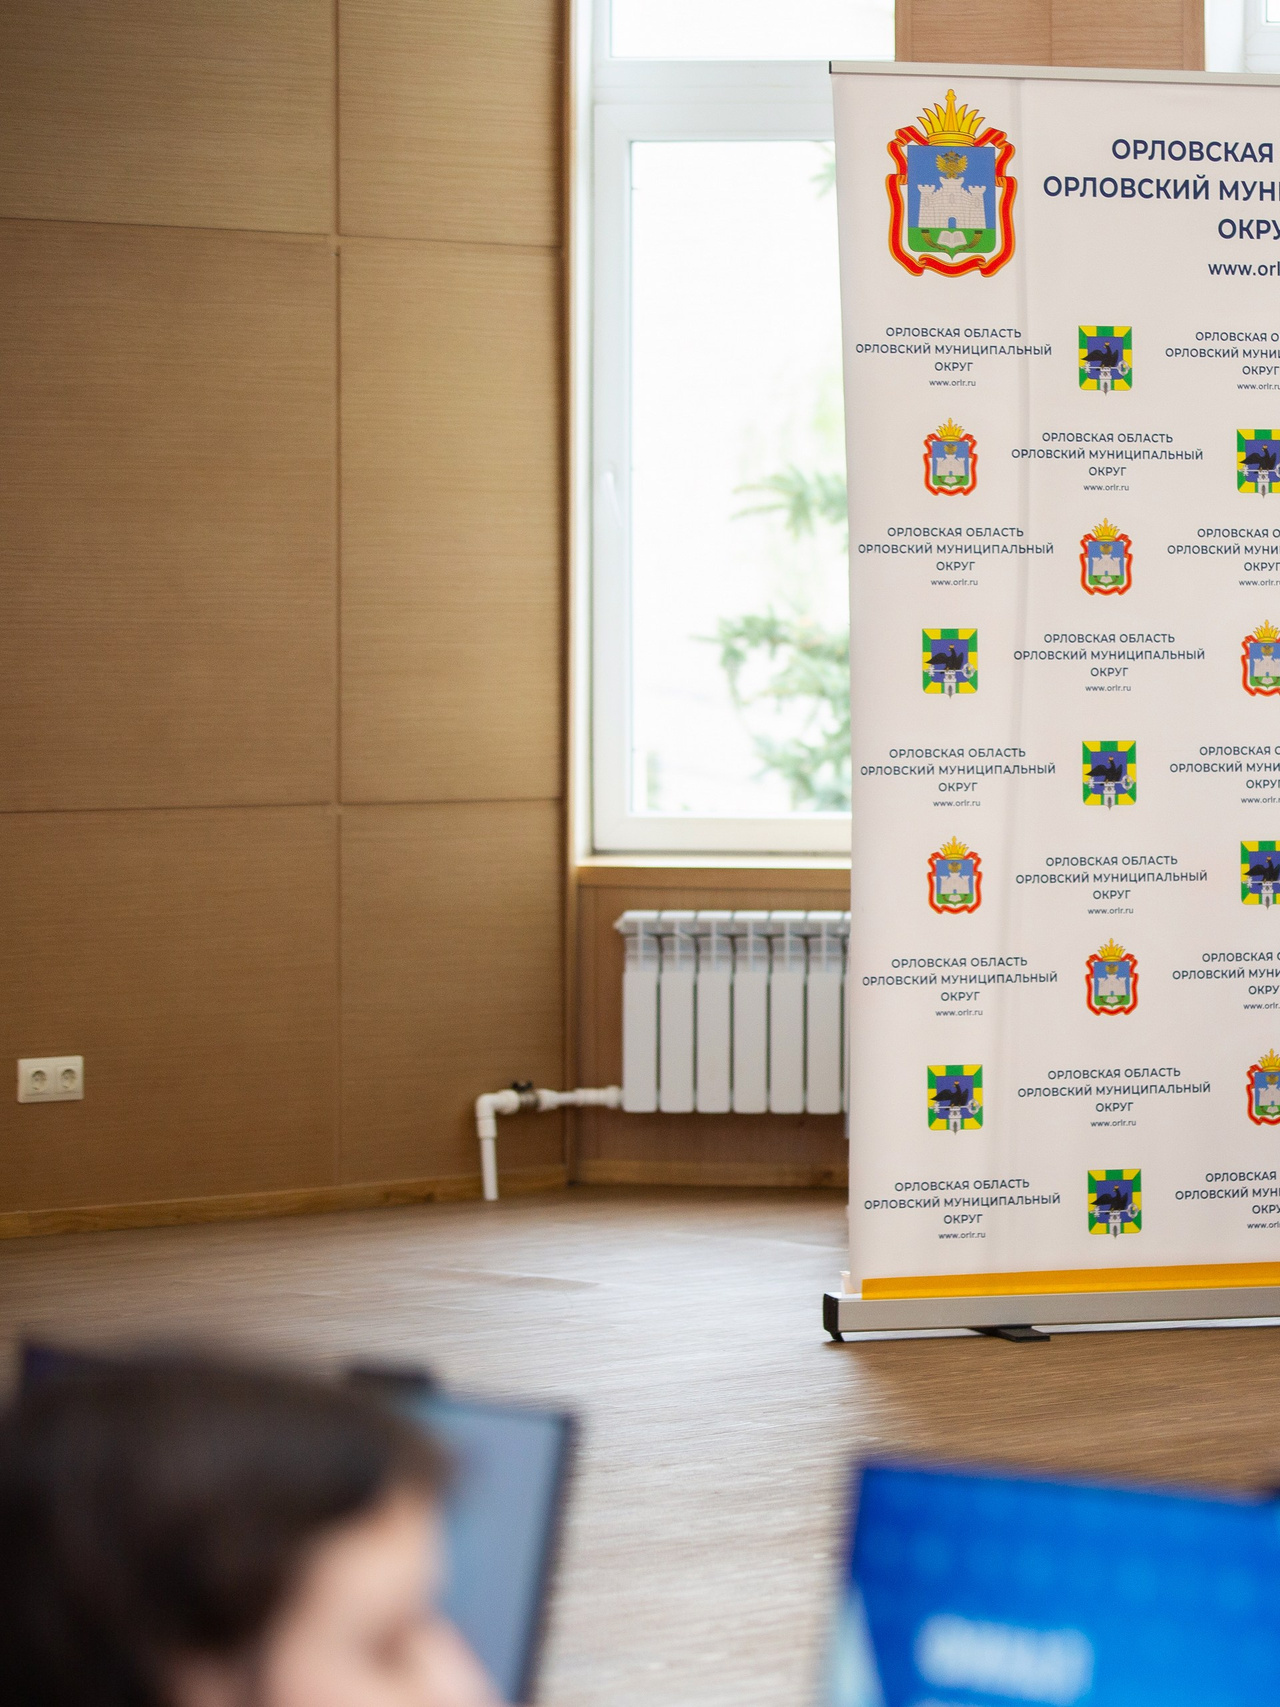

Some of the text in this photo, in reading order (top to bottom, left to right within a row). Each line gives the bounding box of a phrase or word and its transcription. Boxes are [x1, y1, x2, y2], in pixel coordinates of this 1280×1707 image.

[1111, 138, 1274, 164] ОРЛОВСКАЯ
[1043, 173, 1210, 201] ОРЛОВСКИЙ
[885, 326, 1022, 339] ОРЛОВСКАЯ ОБЛАСТЬ
[1195, 331, 1268, 342] ОРЛОВСКАЯ
[855, 342, 1052, 357] ОРЛОВСКИЙ МУНИЦИПАЛЬНЫЙ
[1164, 346, 1239, 359] ОРЛОВСКИЙ
[934, 361, 974, 372] ОКРУГ
[1241, 365, 1280, 376] ОКРУГ
[928, 379, 977, 387] www.orlr.ru
[1041, 432, 1174, 444] ОРЛОВСКАЯ ОБЛАСТЬ
[1011, 447, 1204, 462] ОРЛОВСКИЙ МУНИЦИПАЛЬНЫЙ
[1088, 466, 1127, 477] ОКРУГ
[1083, 483, 1130, 492] www.orlr.ru
[887, 526, 1025, 538] ОРЛОВСКАЯ ОБЛАСТЬ
[1196, 528, 1269, 539] ОРЛОВСКАЯ
[857, 541, 1054, 556] ОРЛОВСКИЙ МУНИЦИПАЛЬНЫЙ
[1166, 542, 1241, 555] ОРЛОВСКИЙ
[935, 561, 976, 571] ОКРУГ
[930, 578, 979, 586] www.orlr.ru
[1043, 633, 1176, 644] ОРЛОВСКАЯ ОБЛАСТЬ
[1013, 649, 1205, 662] ОРЛОВСКИЙ МУНИЦИПАЛЬНЫЙ
[1090, 666, 1129, 677] ОКРУГ
[1084, 684, 1132, 692] www.orlr.ru
[888, 747, 1026, 759] ОРЛОВСКАЯ ОБЛАСТЬ
[1199, 745, 1271, 757] ОРЛОВСКАЯ
[860, 762, 1056, 777] ОРЛОВСКИЙ МУНИЦИПАЛЬНЫЙ
[1169, 760, 1243, 773] ОРЛОВСКИЙ
[938, 781, 979, 793] ОКРУГ
[932, 799, 981, 807] www.orlr.ru
[1045, 855, 1179, 867] ОРЛОВСКАЯ ОБЛАСТЬ
[1015, 869, 1208, 885] ОРЛОВСКИЙ МУНИЦИПАЛЬНЫЙ
[1092, 889, 1132, 900] ОКРУГ
[1087, 907, 1134, 915] www.orlr.ru
[891, 956, 1028, 969] ОРЛОВСКАЯ ОБЛАСТЬ
[1201, 951, 1274, 963] ОРЛОВСКАЯ
[862, 970, 1058, 987] ОРЛОВСКИЙ МУНИЦИПАЛЬНЫЙ
[1171, 966, 1245, 981] ОРЛОВСКИЙ
[940, 991, 981, 1002] ОКРУГ
[935, 1009, 983, 1017] www.orlr.ru
[1047, 1067, 1181, 1081] ОРЛОВСКАЯ ОБЛАСТЬ
[1017, 1080, 1211, 1098] ОРЛОВСКИЙ МУНИЦИПАЛЬНЫЙ
[1095, 1101, 1134, 1113] ОКРУГ
[1090, 1119, 1137, 1127] www.orlr.ru
[1205, 1170, 1277, 1183] ОРЛОВСКАЯ
[894, 1178, 1030, 1192] ОРЛОВСКАЯ ОБЛАСТЬ
[1174, 1186, 1249, 1201] ОРЛОВСКИЙ
[863, 1192, 1061, 1210] ОРЛОВСКИЙ МУНИЦИПАЛЬНЫЙ
[943, 1213, 984, 1225] ОКРУГ
[938, 1231, 986, 1240] www.orlr.ru
